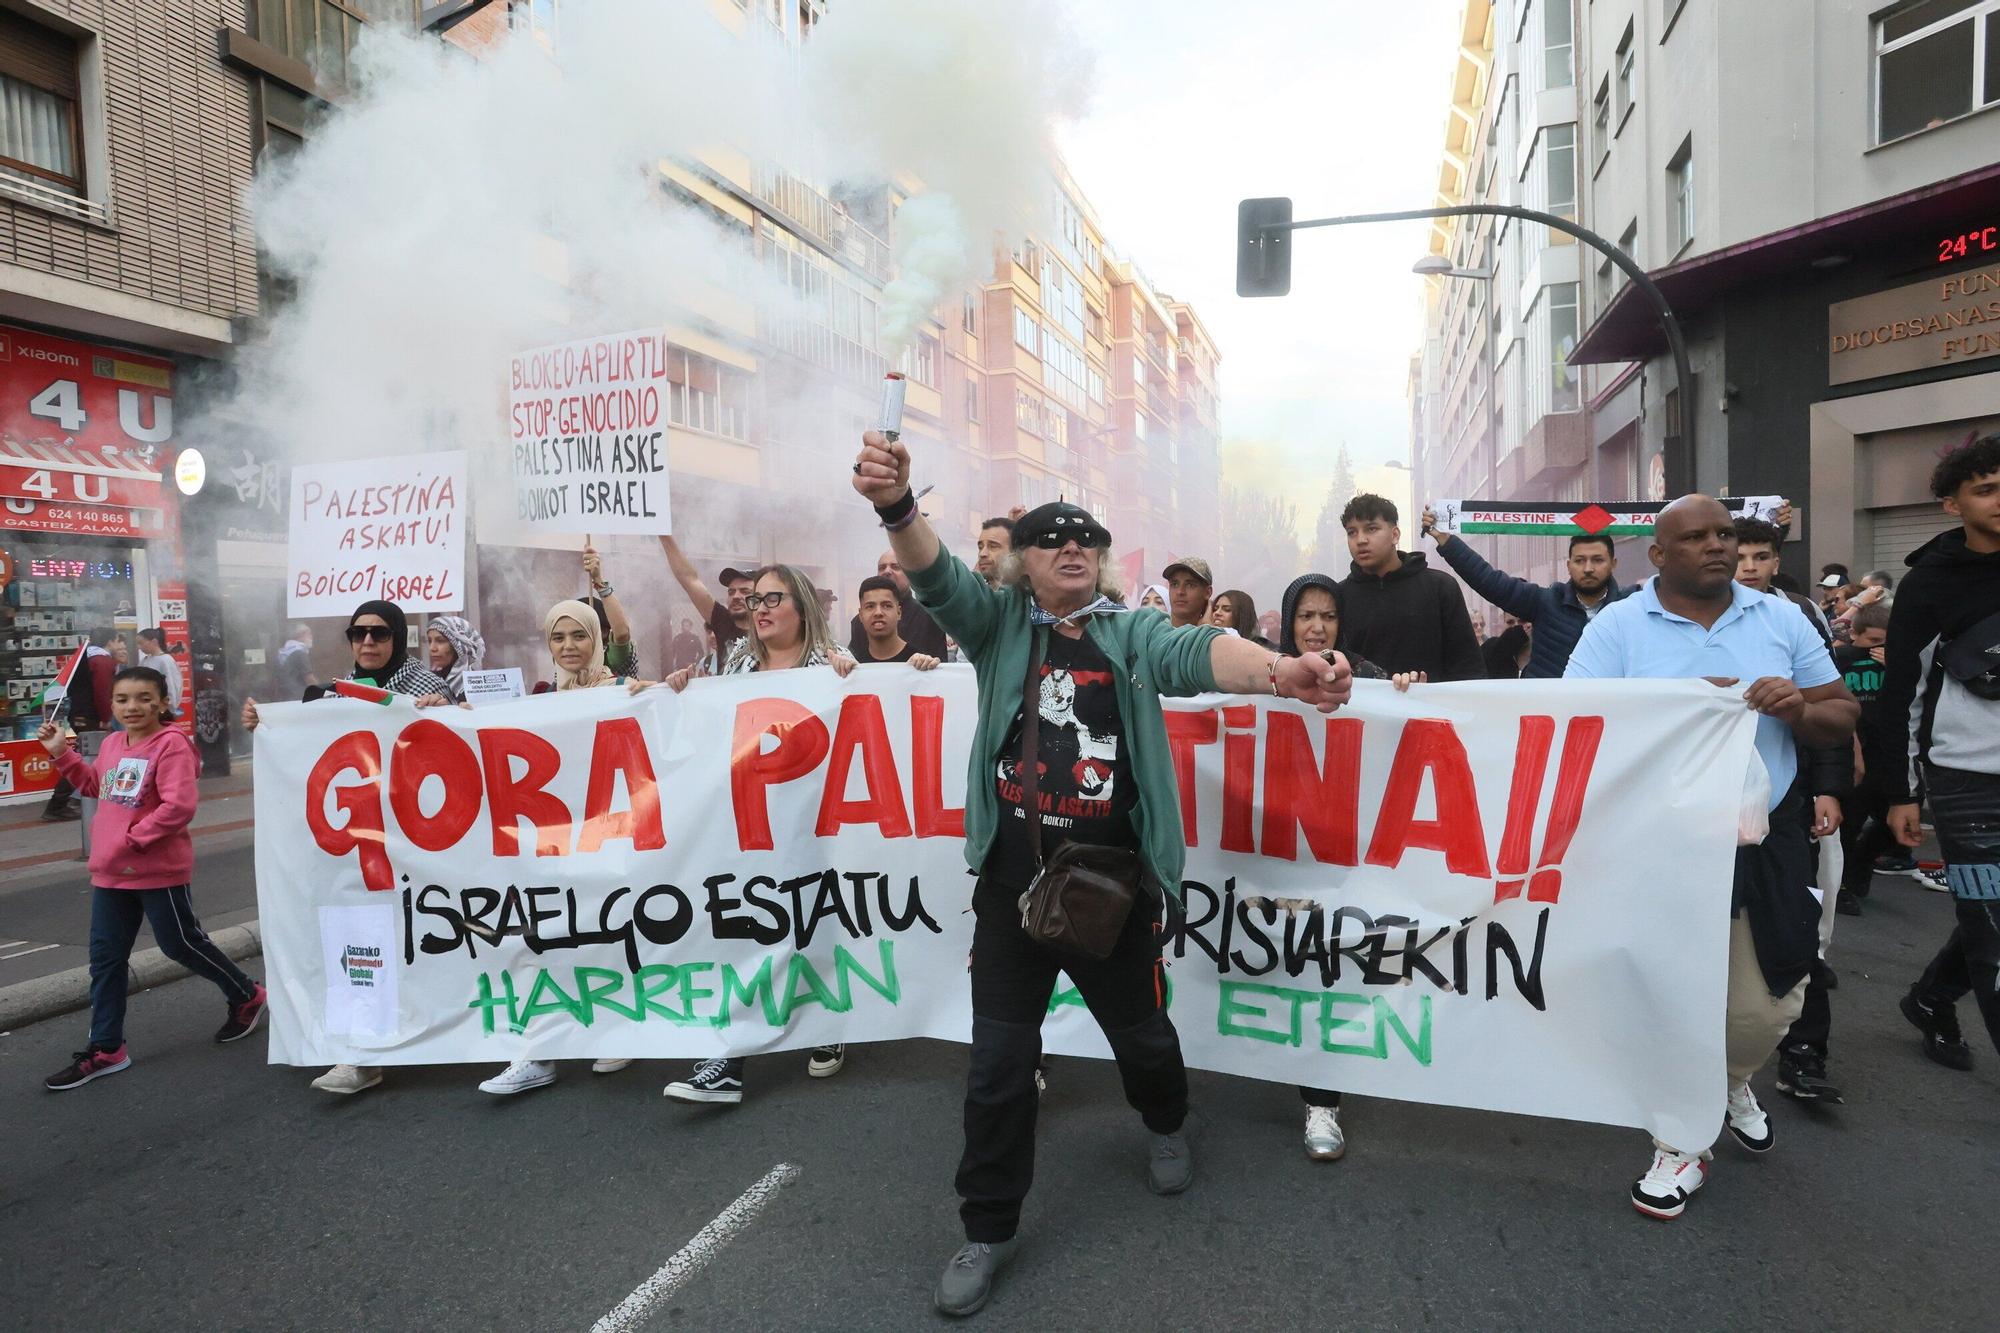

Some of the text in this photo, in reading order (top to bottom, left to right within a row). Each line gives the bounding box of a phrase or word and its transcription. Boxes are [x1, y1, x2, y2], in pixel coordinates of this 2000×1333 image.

[1939, 227, 1996, 261] 24°C
[1832, 301, 2000, 354] DIOCESANAS
[30, 379, 173, 442] 4 U
[514, 432, 664, 475] PALESTINA ASKE
[21, 471, 109, 502] 4 U
[518, 480, 656, 521] BOIKOT ISRAEL
[48, 509, 124, 524] 624 140 865
[340, 513, 450, 550] ASKATU!
[1473, 512, 1556, 524] PALESTINE
[24, 757, 50, 772] ria
[306, 717, 667, 891] GORA
[703, 868, 942, 950] ESTATU
[469, 938, 900, 1038] HARREMAN
[1218, 978, 1433, 1067] ETEN
